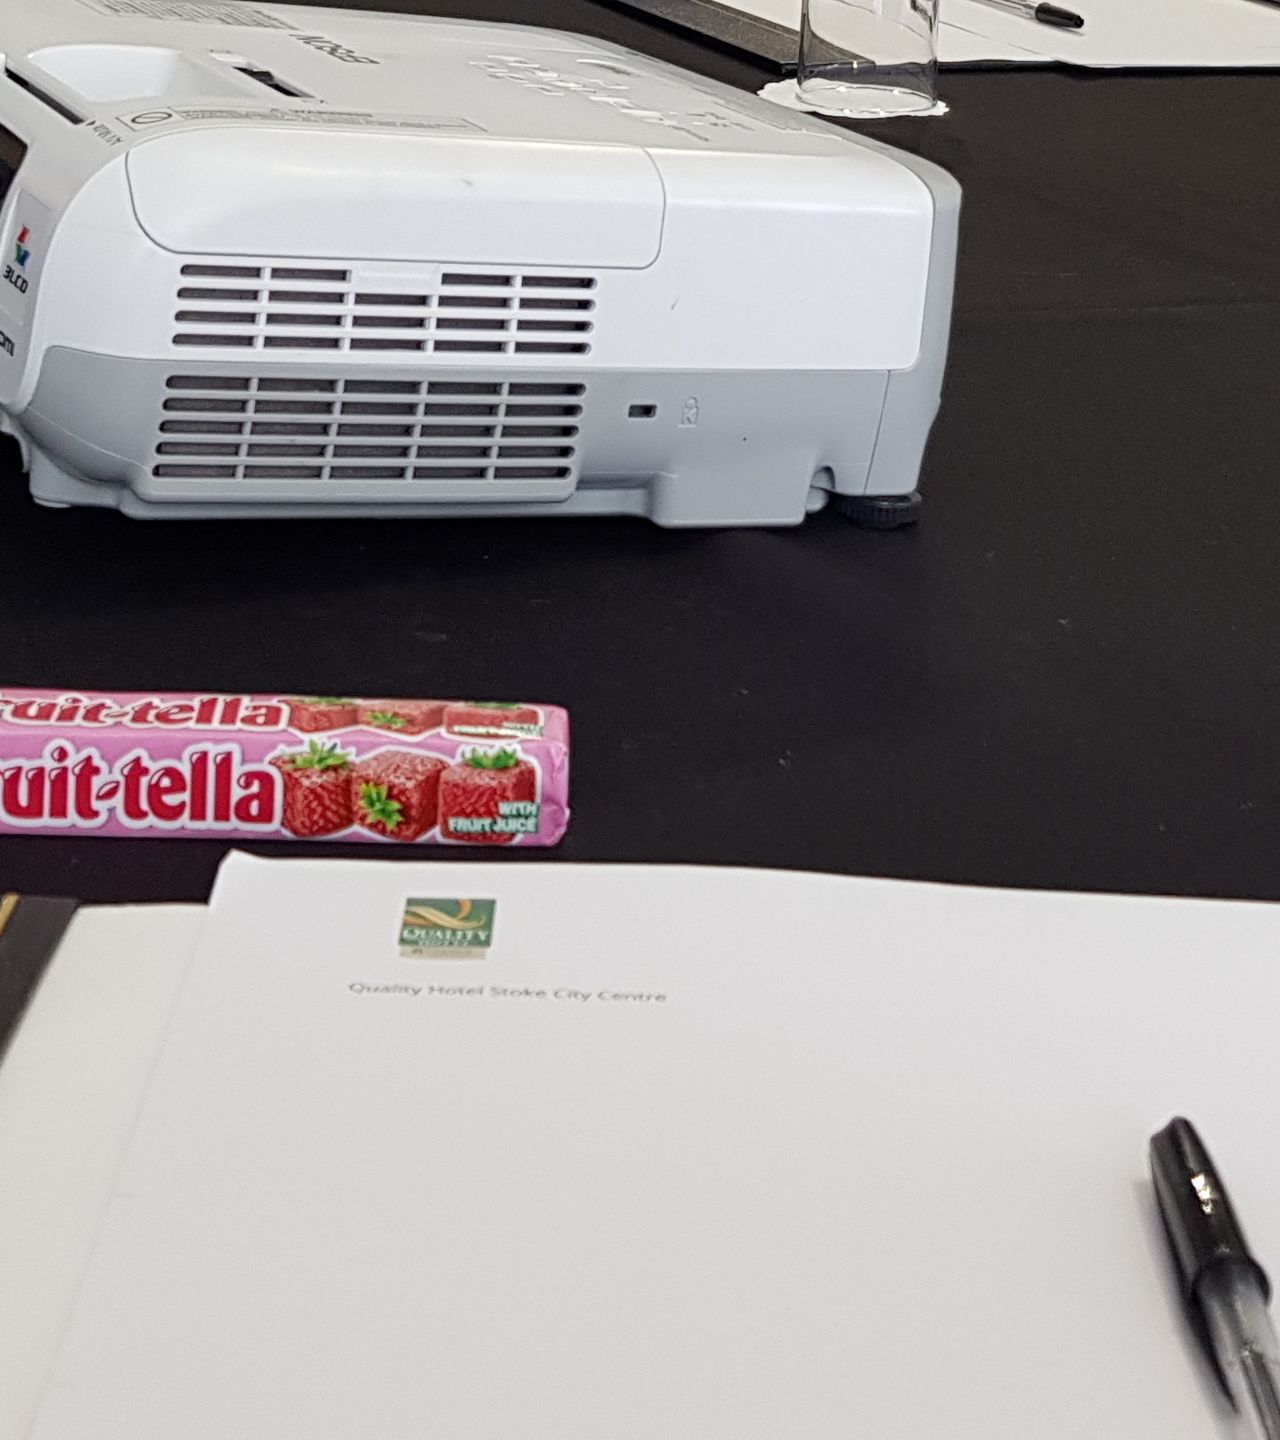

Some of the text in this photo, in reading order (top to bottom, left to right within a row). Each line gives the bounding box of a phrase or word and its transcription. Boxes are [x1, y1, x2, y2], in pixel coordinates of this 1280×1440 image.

[2, 264, 29, 295] 3LCD
[447, 816, 538, 834] FRUIT JUICE
[402, 928, 489, 941] QUALITY
[348, 981, 667, 1003] Quality Hotel Stoke City Centre
